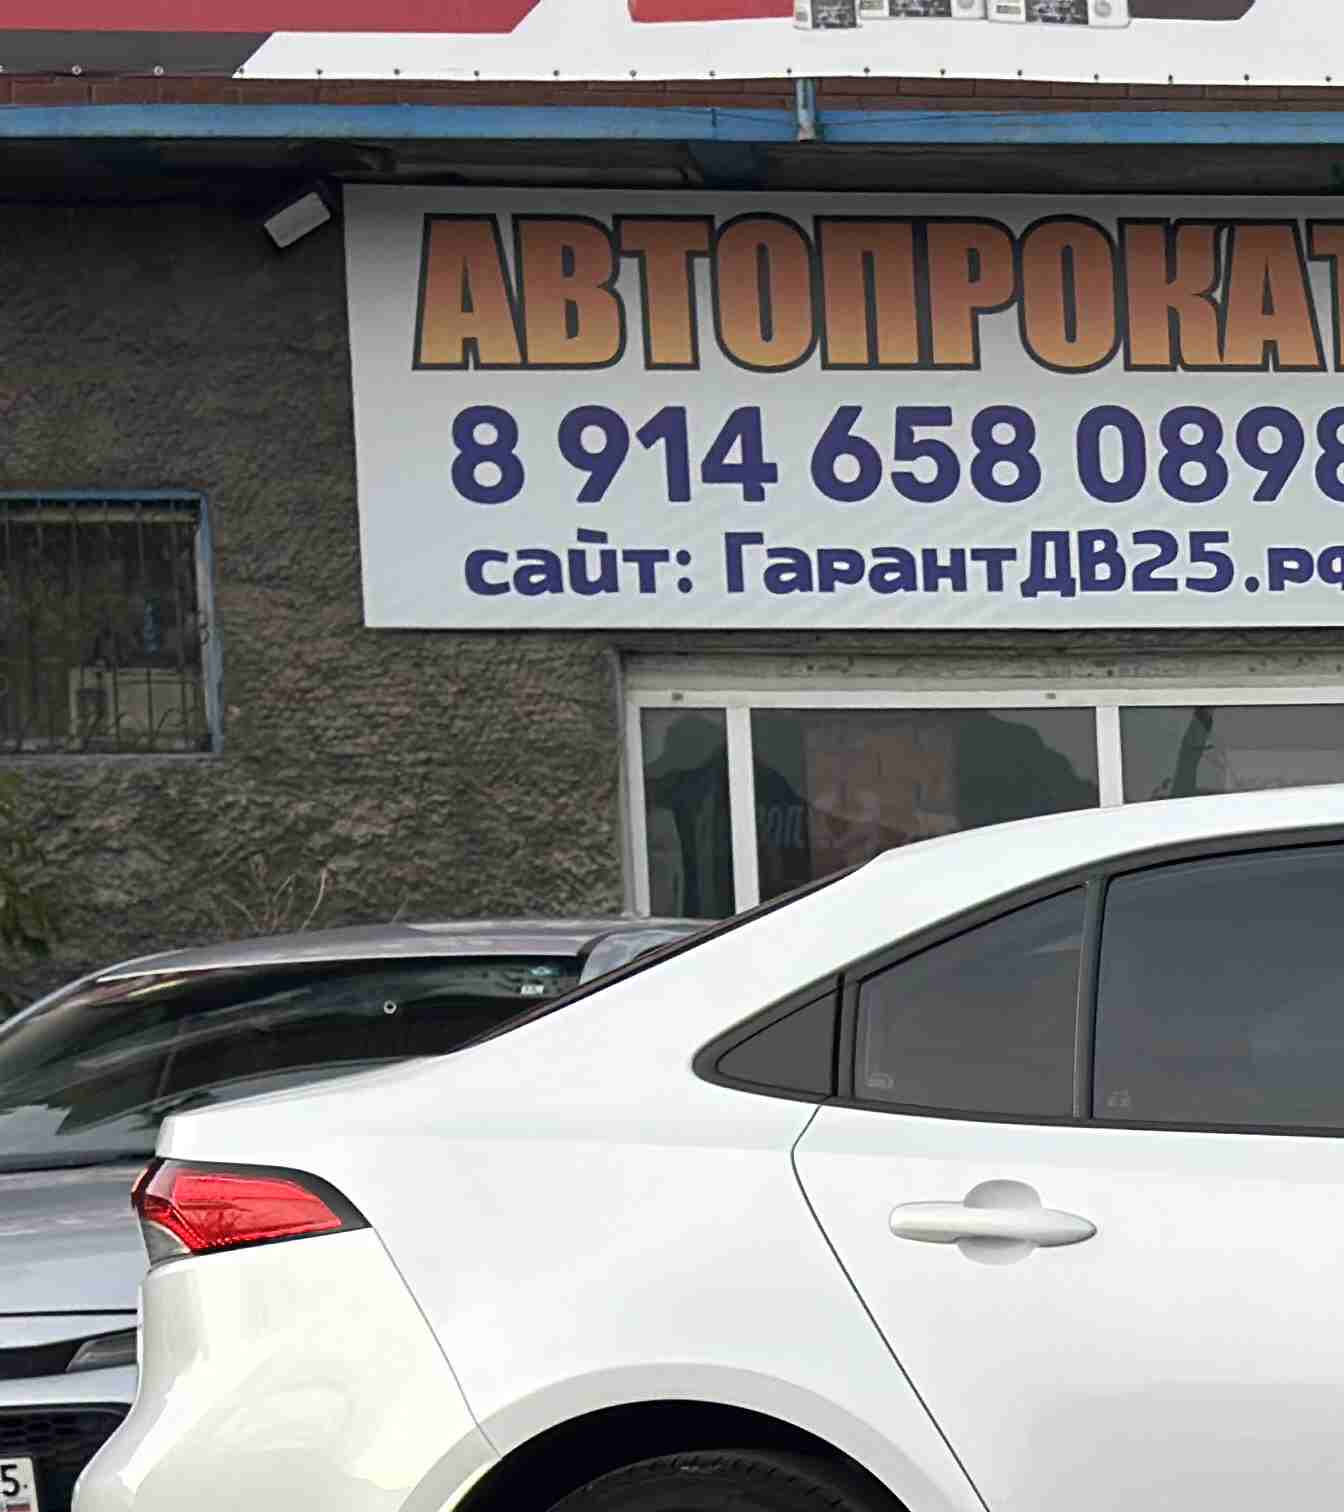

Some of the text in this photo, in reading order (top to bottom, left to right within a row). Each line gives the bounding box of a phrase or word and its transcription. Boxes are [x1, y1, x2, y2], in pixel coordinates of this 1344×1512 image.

[451, 404, 526, 504] 8
[557, 404, 778, 503] 914
[810, 404, 1042, 503] 658
[464, 527, 693, 596] сайт:
